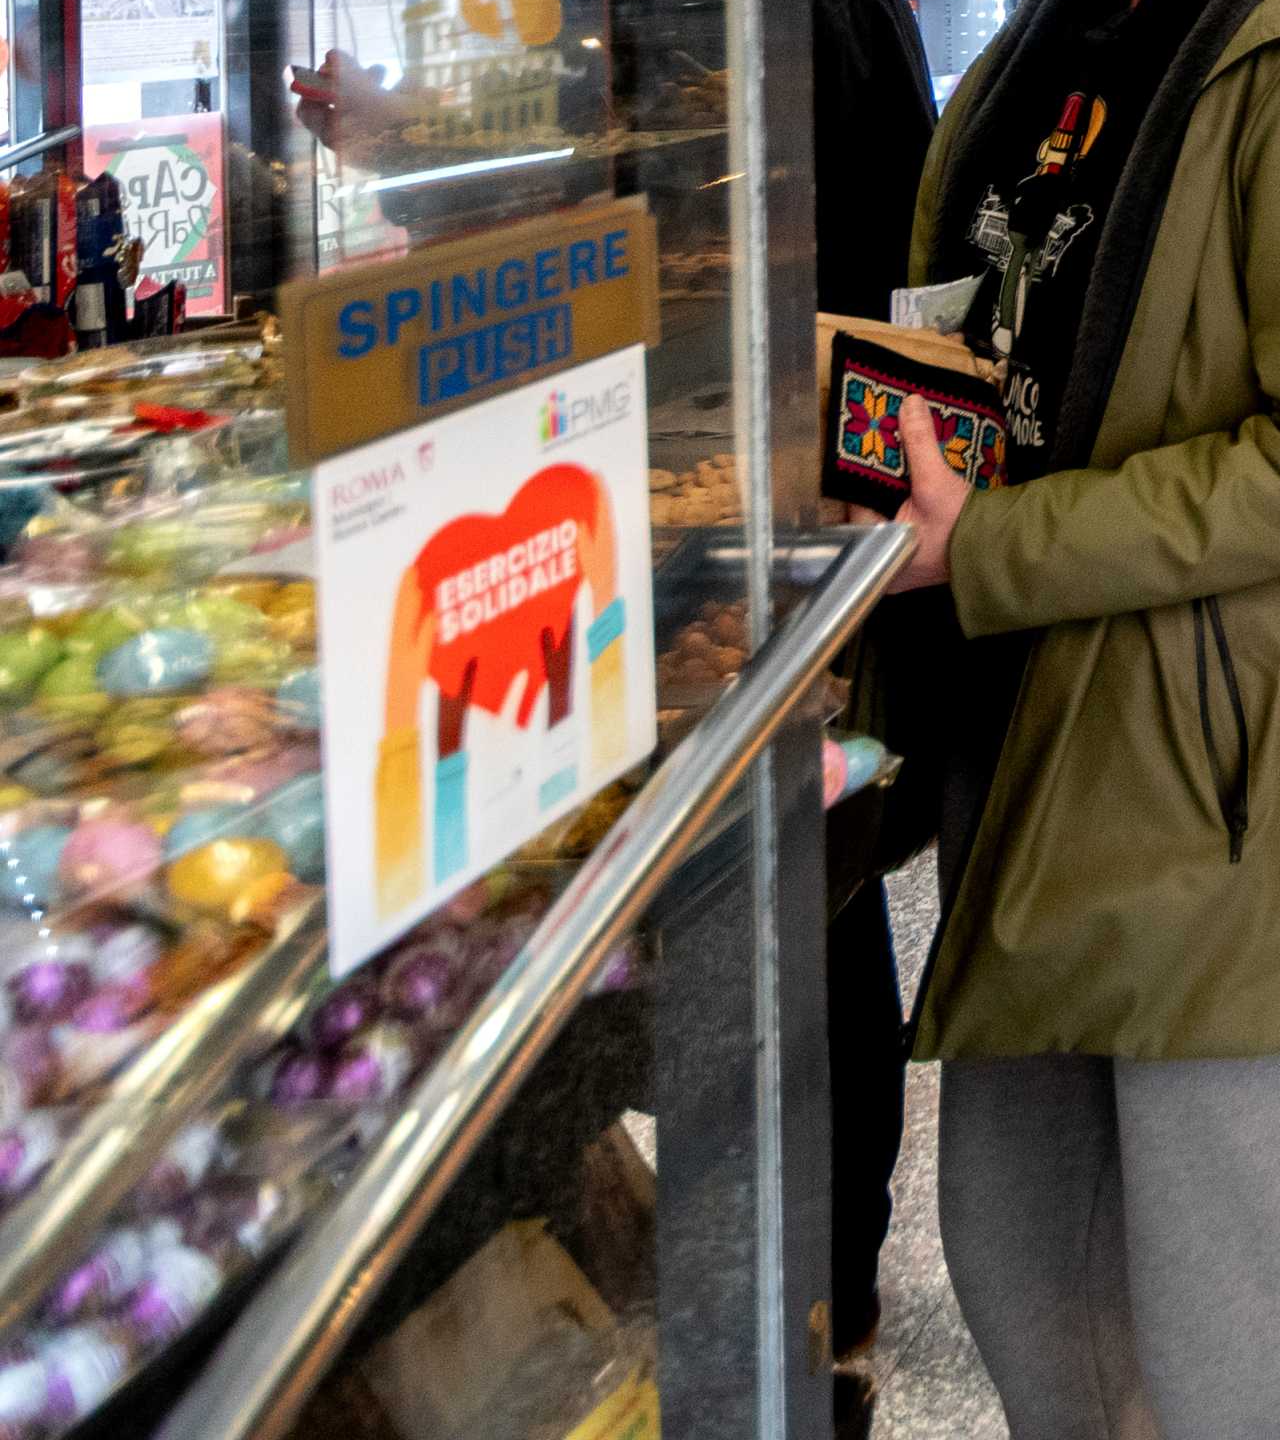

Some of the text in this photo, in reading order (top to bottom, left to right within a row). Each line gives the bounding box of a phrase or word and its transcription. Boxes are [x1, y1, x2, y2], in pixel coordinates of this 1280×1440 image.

[336, 229, 631, 359] SPINGERE
[420, 304, 572, 406] PUSH
[435, 517, 579, 612] ESERCIZIO
[438, 545, 577, 646] SOLIDALE
